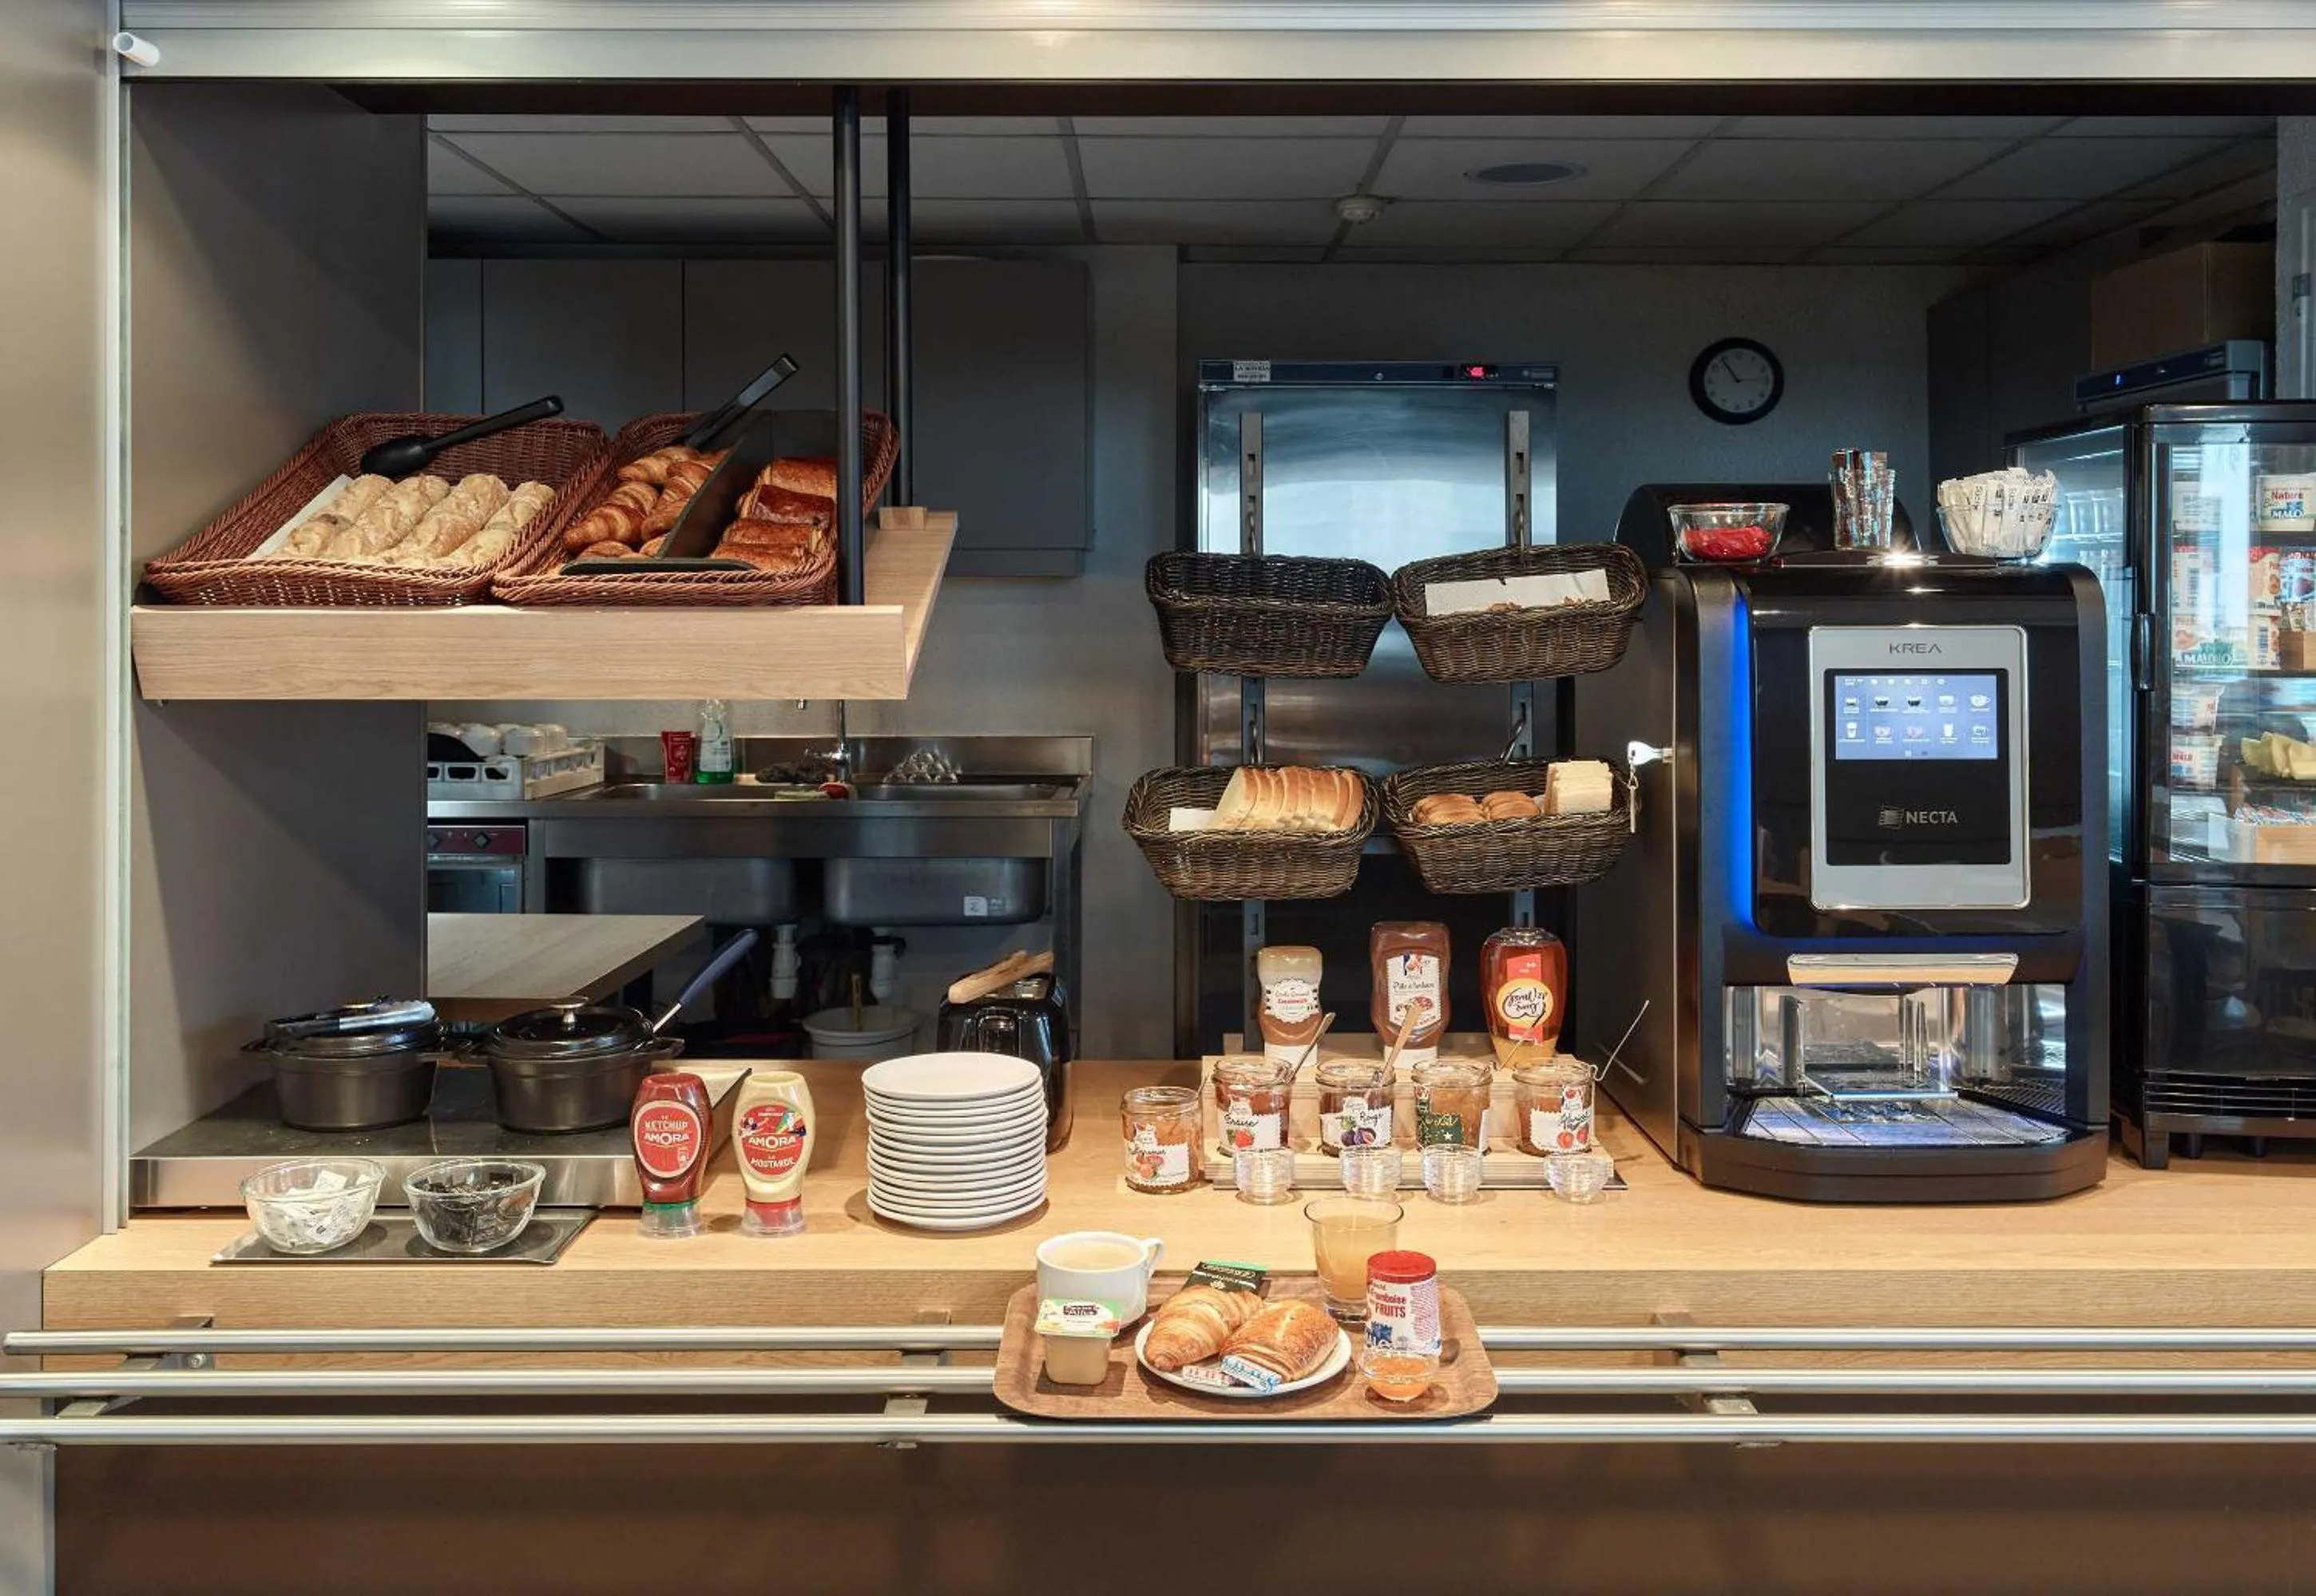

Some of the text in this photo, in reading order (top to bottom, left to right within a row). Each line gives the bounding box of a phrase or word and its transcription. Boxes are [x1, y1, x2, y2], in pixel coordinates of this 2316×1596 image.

[1889, 644, 1942, 654] KREA
[1906, 810, 1959, 824] NECTA
[644, 1120, 689, 1131] KETCHUP
[644, 1132, 690, 1145] AMORA
[748, 1135, 796, 1149] AMORA
[1374, 1302, 1406, 1318] FRUITS
